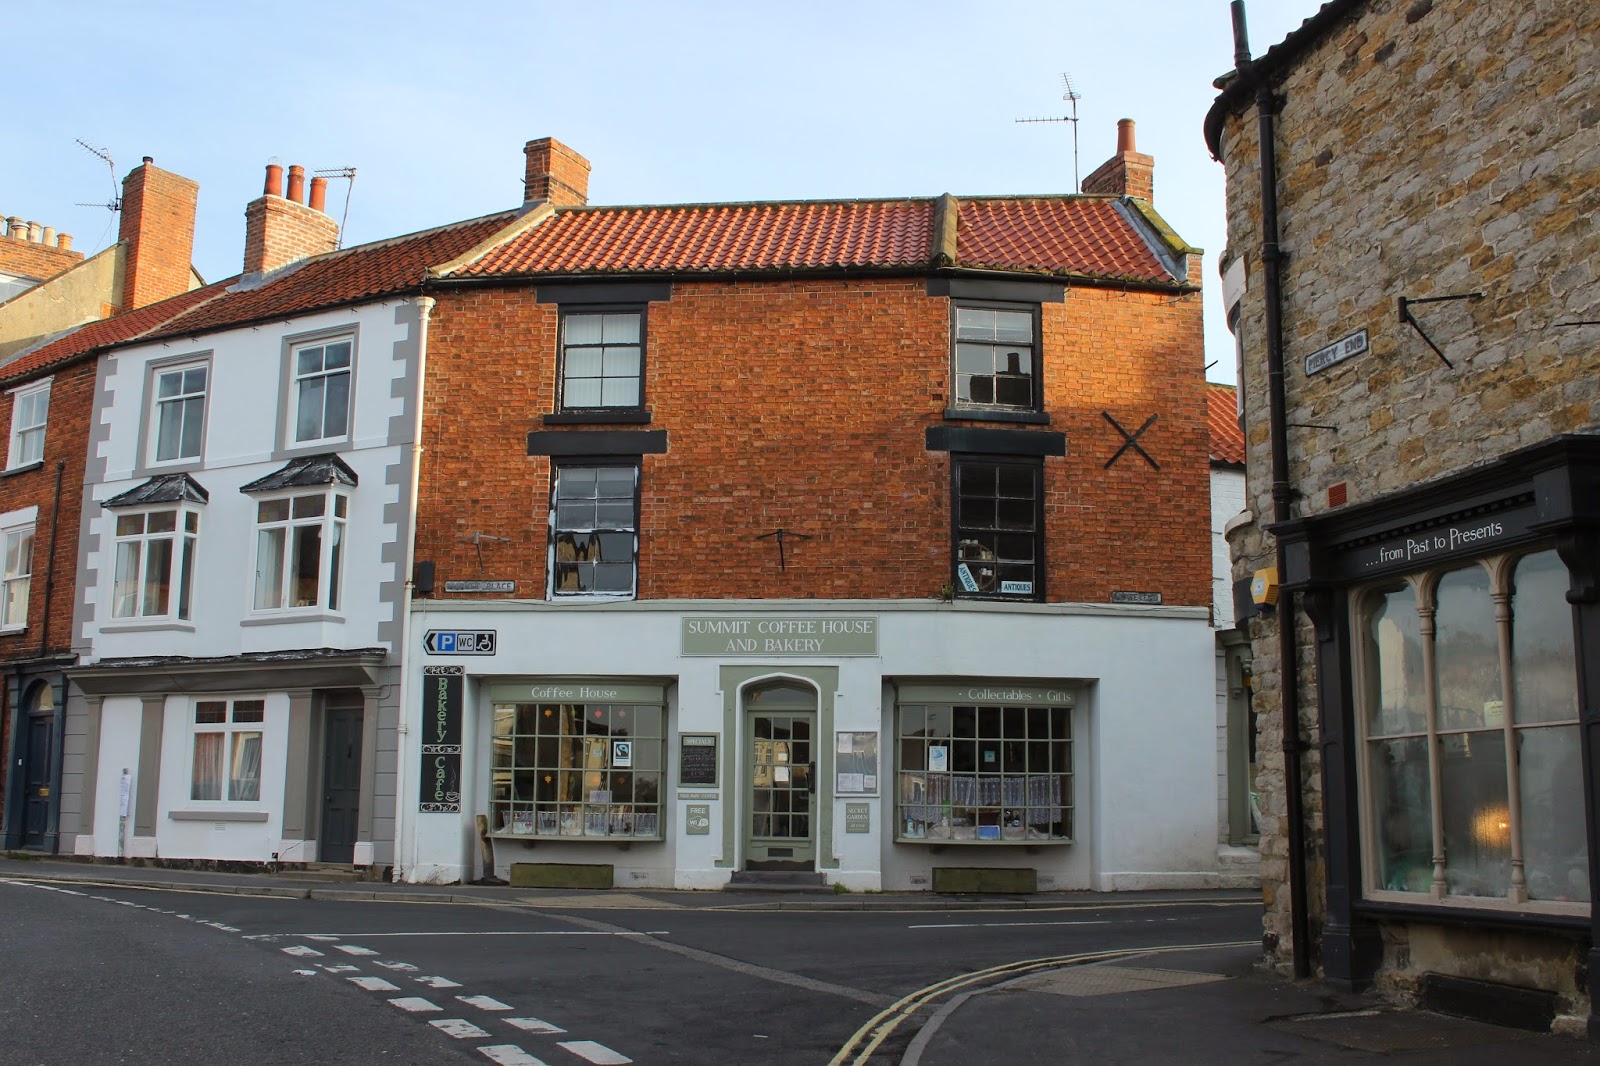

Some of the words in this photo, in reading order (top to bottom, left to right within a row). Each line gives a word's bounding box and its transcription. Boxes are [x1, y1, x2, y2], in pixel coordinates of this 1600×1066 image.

[1308, 345, 1338, 371] PIERCY
[1344, 335, 1363, 354] END
[1406, 539, 1429, 560] Past
[1434, 537, 1446, 549] to
[1449, 522, 1503, 550] Presents
[486, 582, 511, 590] PLACE
[959, 566, 977, 592] ANTIQUES
[1004, 583, 1031, 591] ANTIQUES
[688, 621, 750, 634] SUMMIT
[757, 621, 816, 634] COFFEE
[822, 621, 873, 634] HOUSE
[441, 635, 453, 650] P
[459, 637, 472, 647] WC
[725, 638, 757, 652] AND
[764, 638, 825, 652] BAKERY
[531, 686, 573, 698] Coffee
[580, 687, 617, 698] House
[968, 688, 1032, 700] Collectables
[1046, 690, 1071, 702] Gifts
[437, 677, 448, 742] Bakery
[434, 756, 446, 801] Cafe
